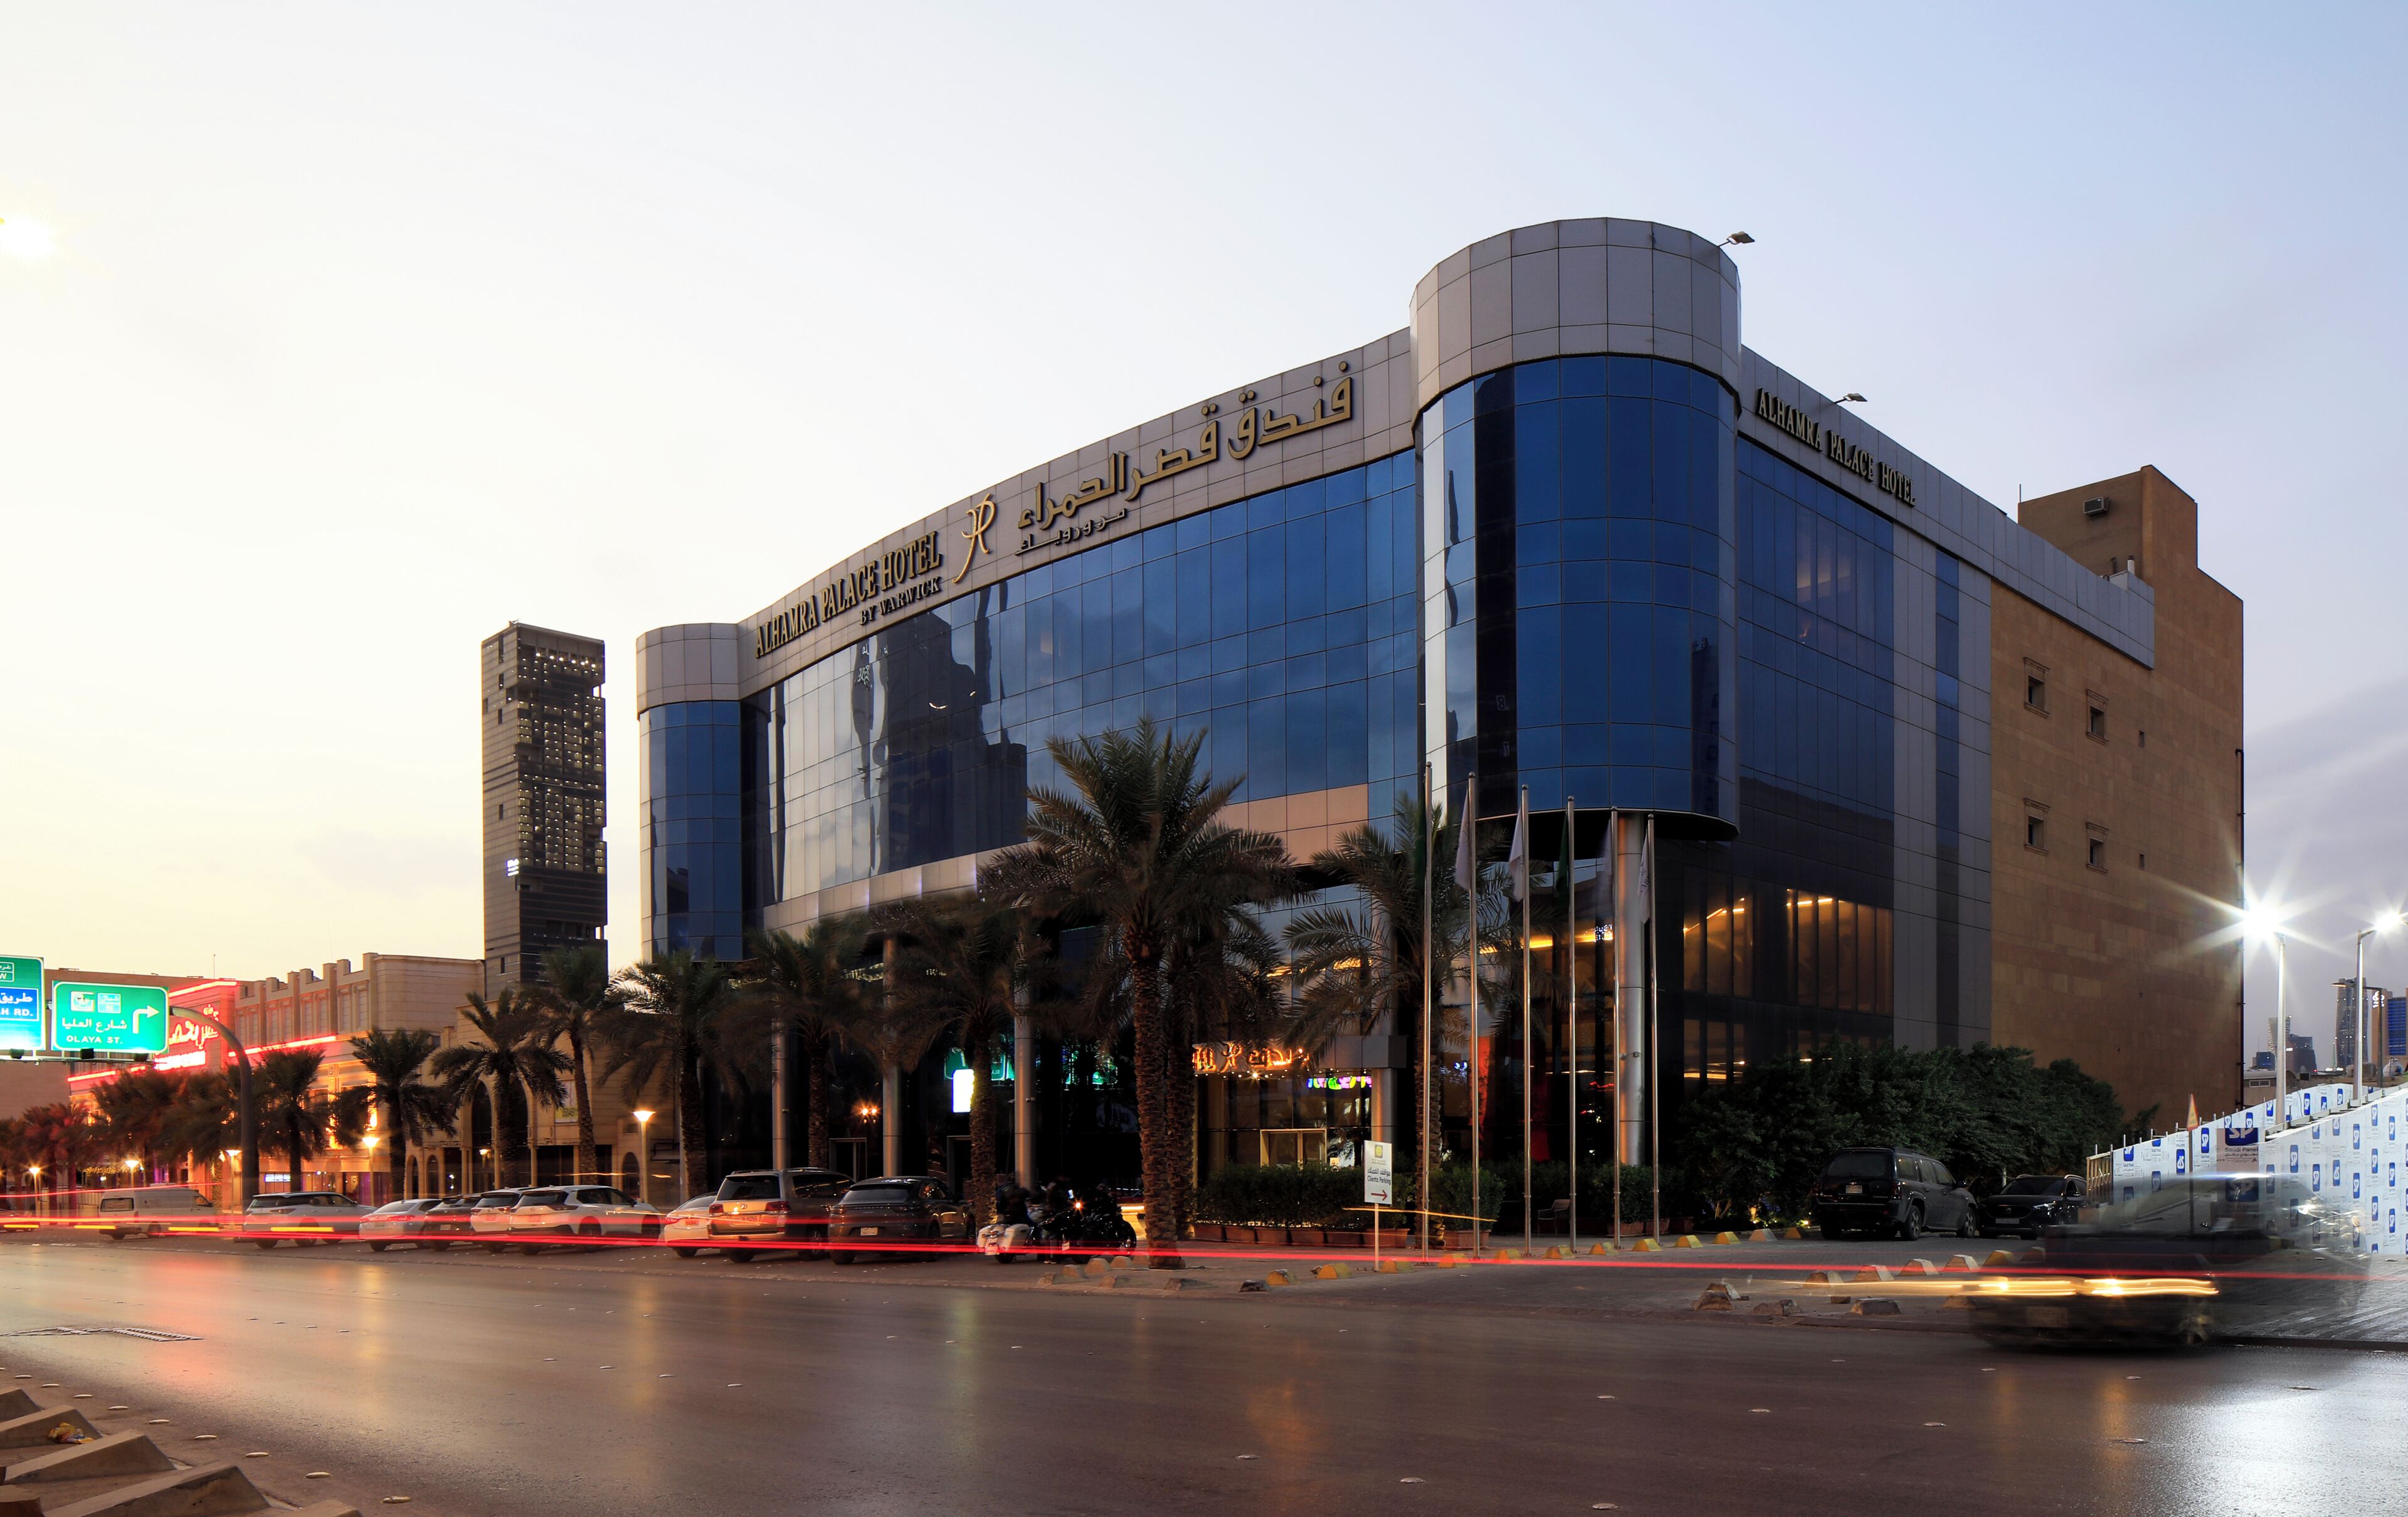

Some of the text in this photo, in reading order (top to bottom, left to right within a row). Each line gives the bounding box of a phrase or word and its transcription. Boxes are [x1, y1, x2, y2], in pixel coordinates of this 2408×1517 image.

[1017, 361, 1353, 531] فندق قصر الحمراء
[1756, 388, 1916, 507] ALHAMRA PALACE HOTEL
[1094, 508, 1127, 531] من
[755, 531, 943, 659] ALHAMRA PALACE HOTEL
[859, 576, 941, 625] BY WARWICK
[61, 1017, 128, 1033] شارع العليا
[66, 1035, 102, 1043] OLAYA
[1379, 1177, 1391, 1186] Parking
